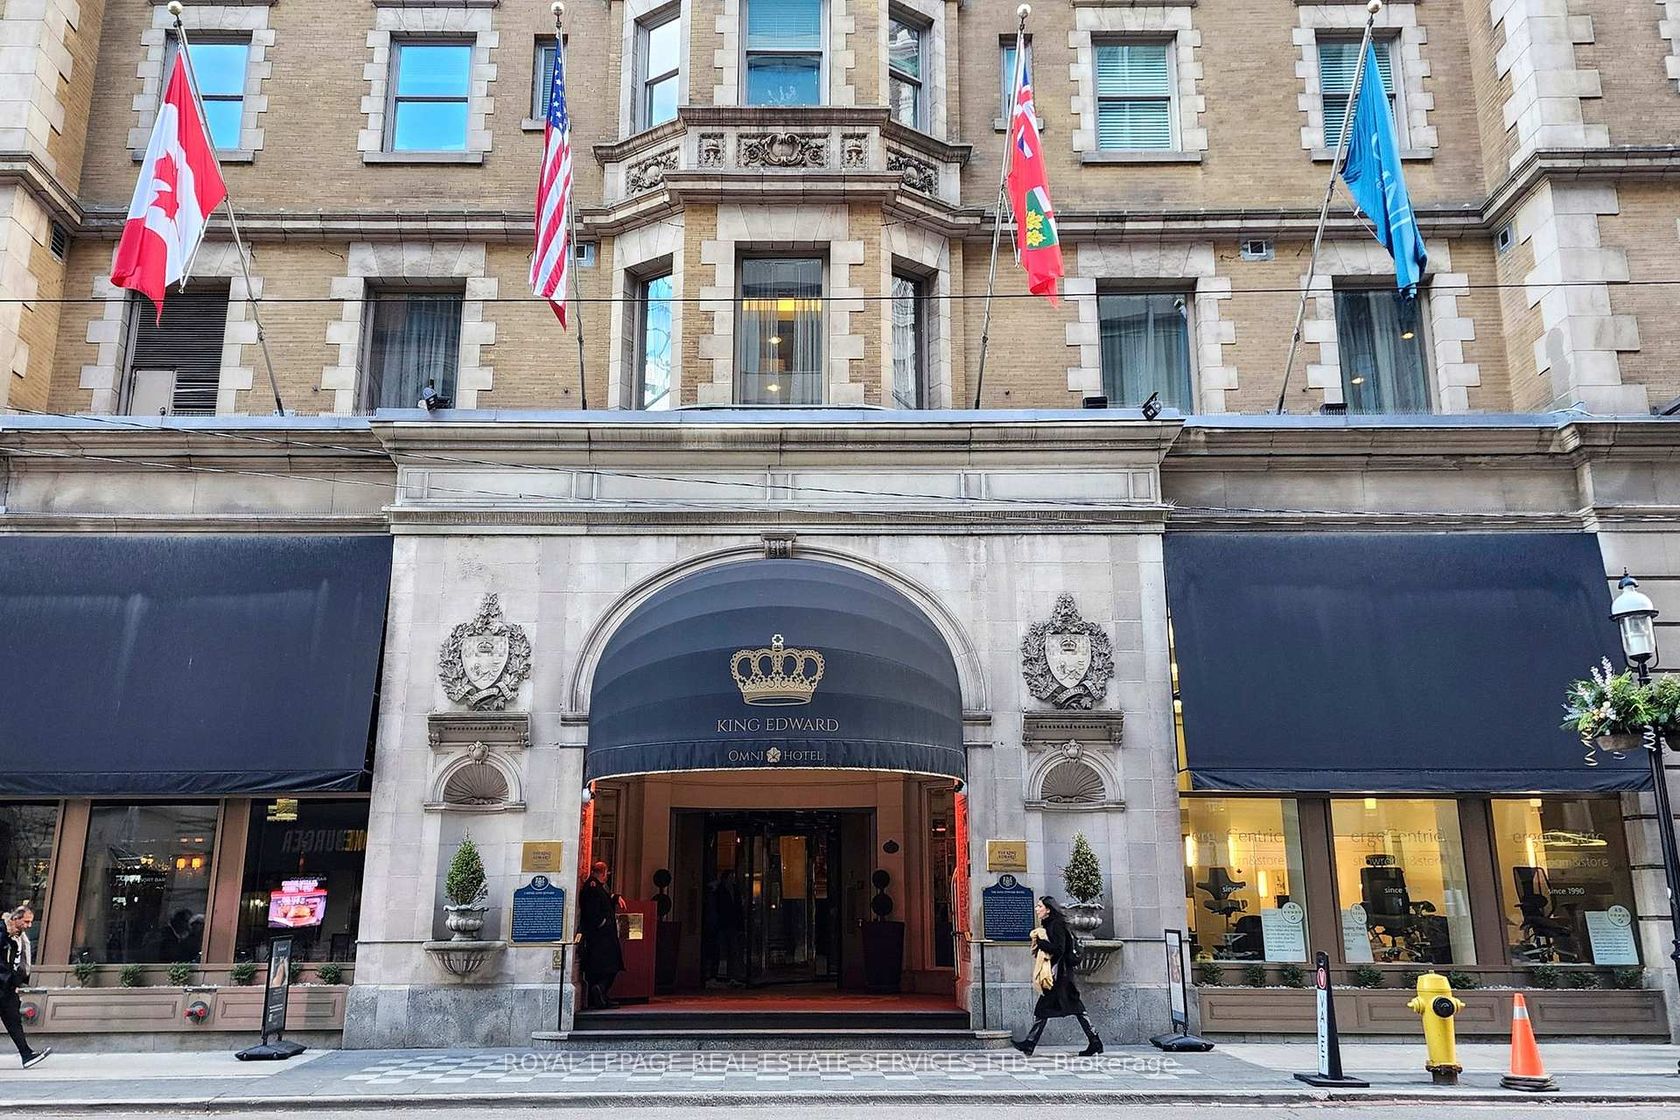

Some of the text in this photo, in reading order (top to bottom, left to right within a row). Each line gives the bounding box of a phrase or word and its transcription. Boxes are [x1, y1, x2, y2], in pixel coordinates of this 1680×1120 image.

[716, 717, 839, 732] KING EDWARD
[728, 750, 824, 762] OMNI HOTEL
[1384, 885, 1403, 894] since
